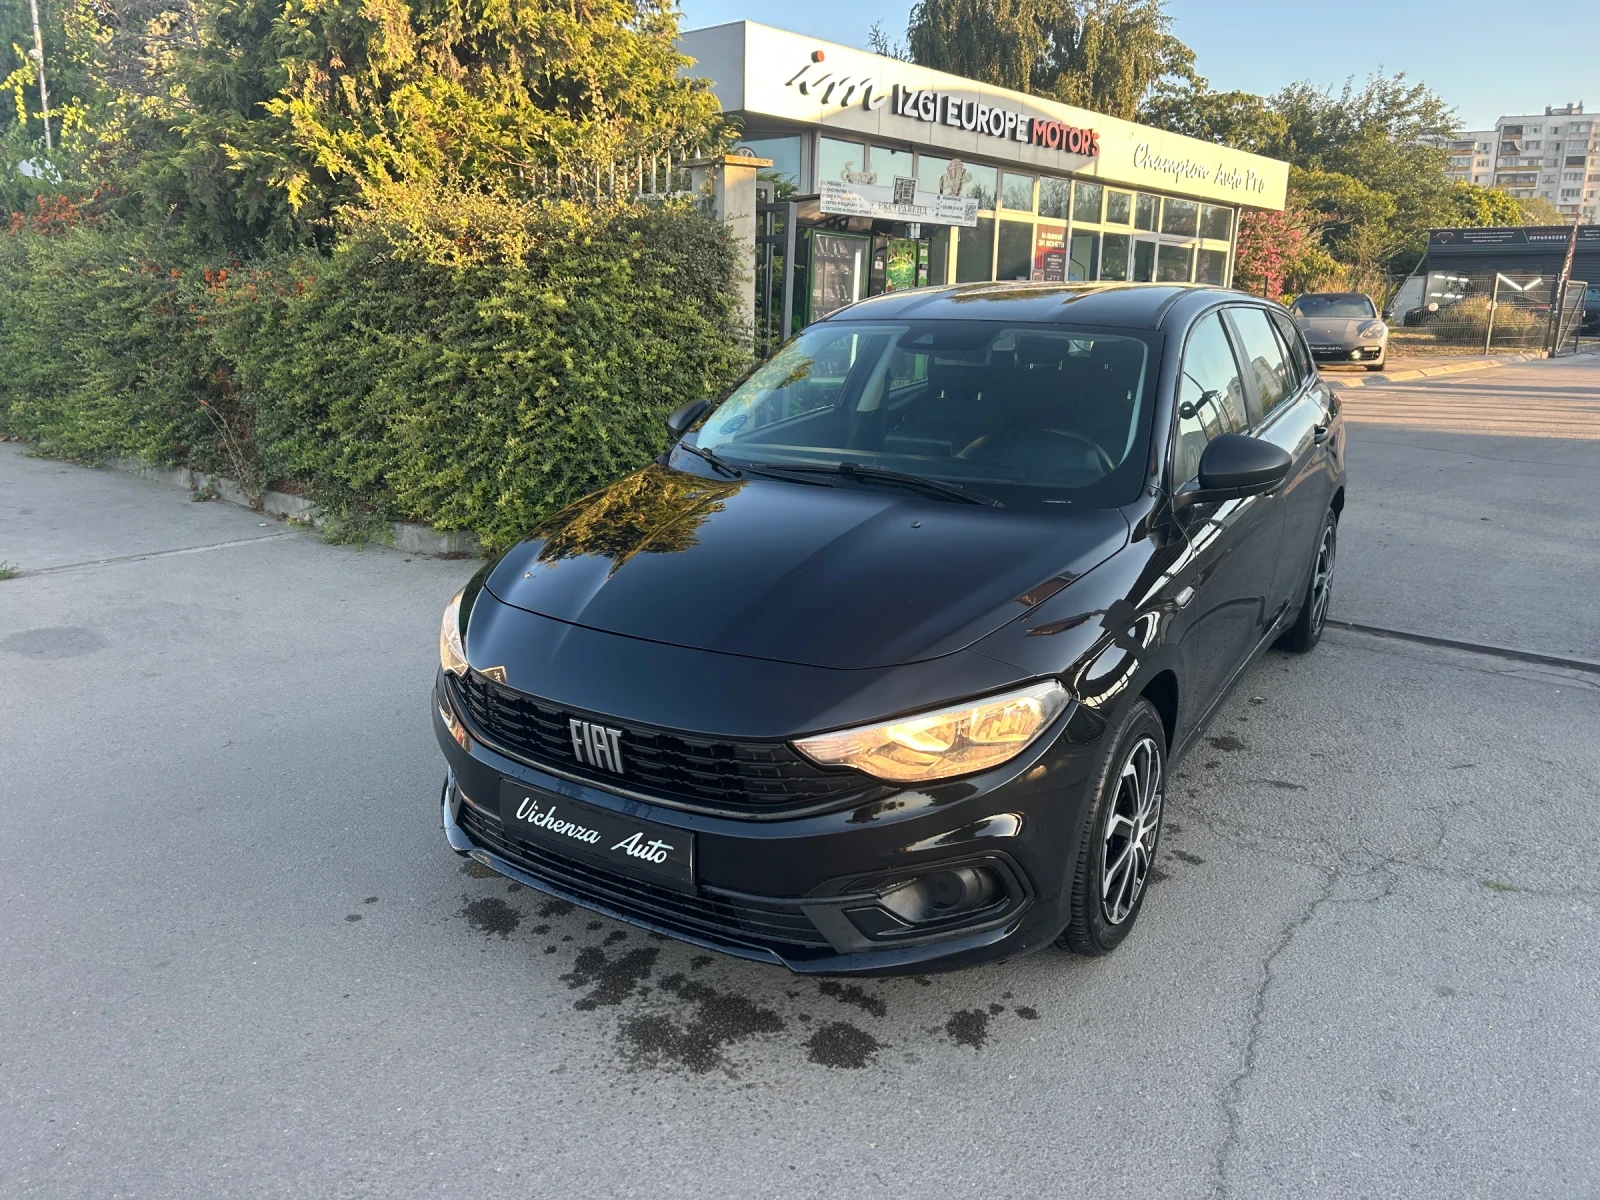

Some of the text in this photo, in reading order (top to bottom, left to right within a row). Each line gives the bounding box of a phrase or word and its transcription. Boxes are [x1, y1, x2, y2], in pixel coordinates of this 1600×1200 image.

[893, 84, 940, 123] IZGI
[944, 95, 1032, 143] EUROPE
[1134, 143, 1264, 194] Champion Auto Pro
[569, 718, 625, 775] FIAT
[611, 832, 675, 864] Auto
